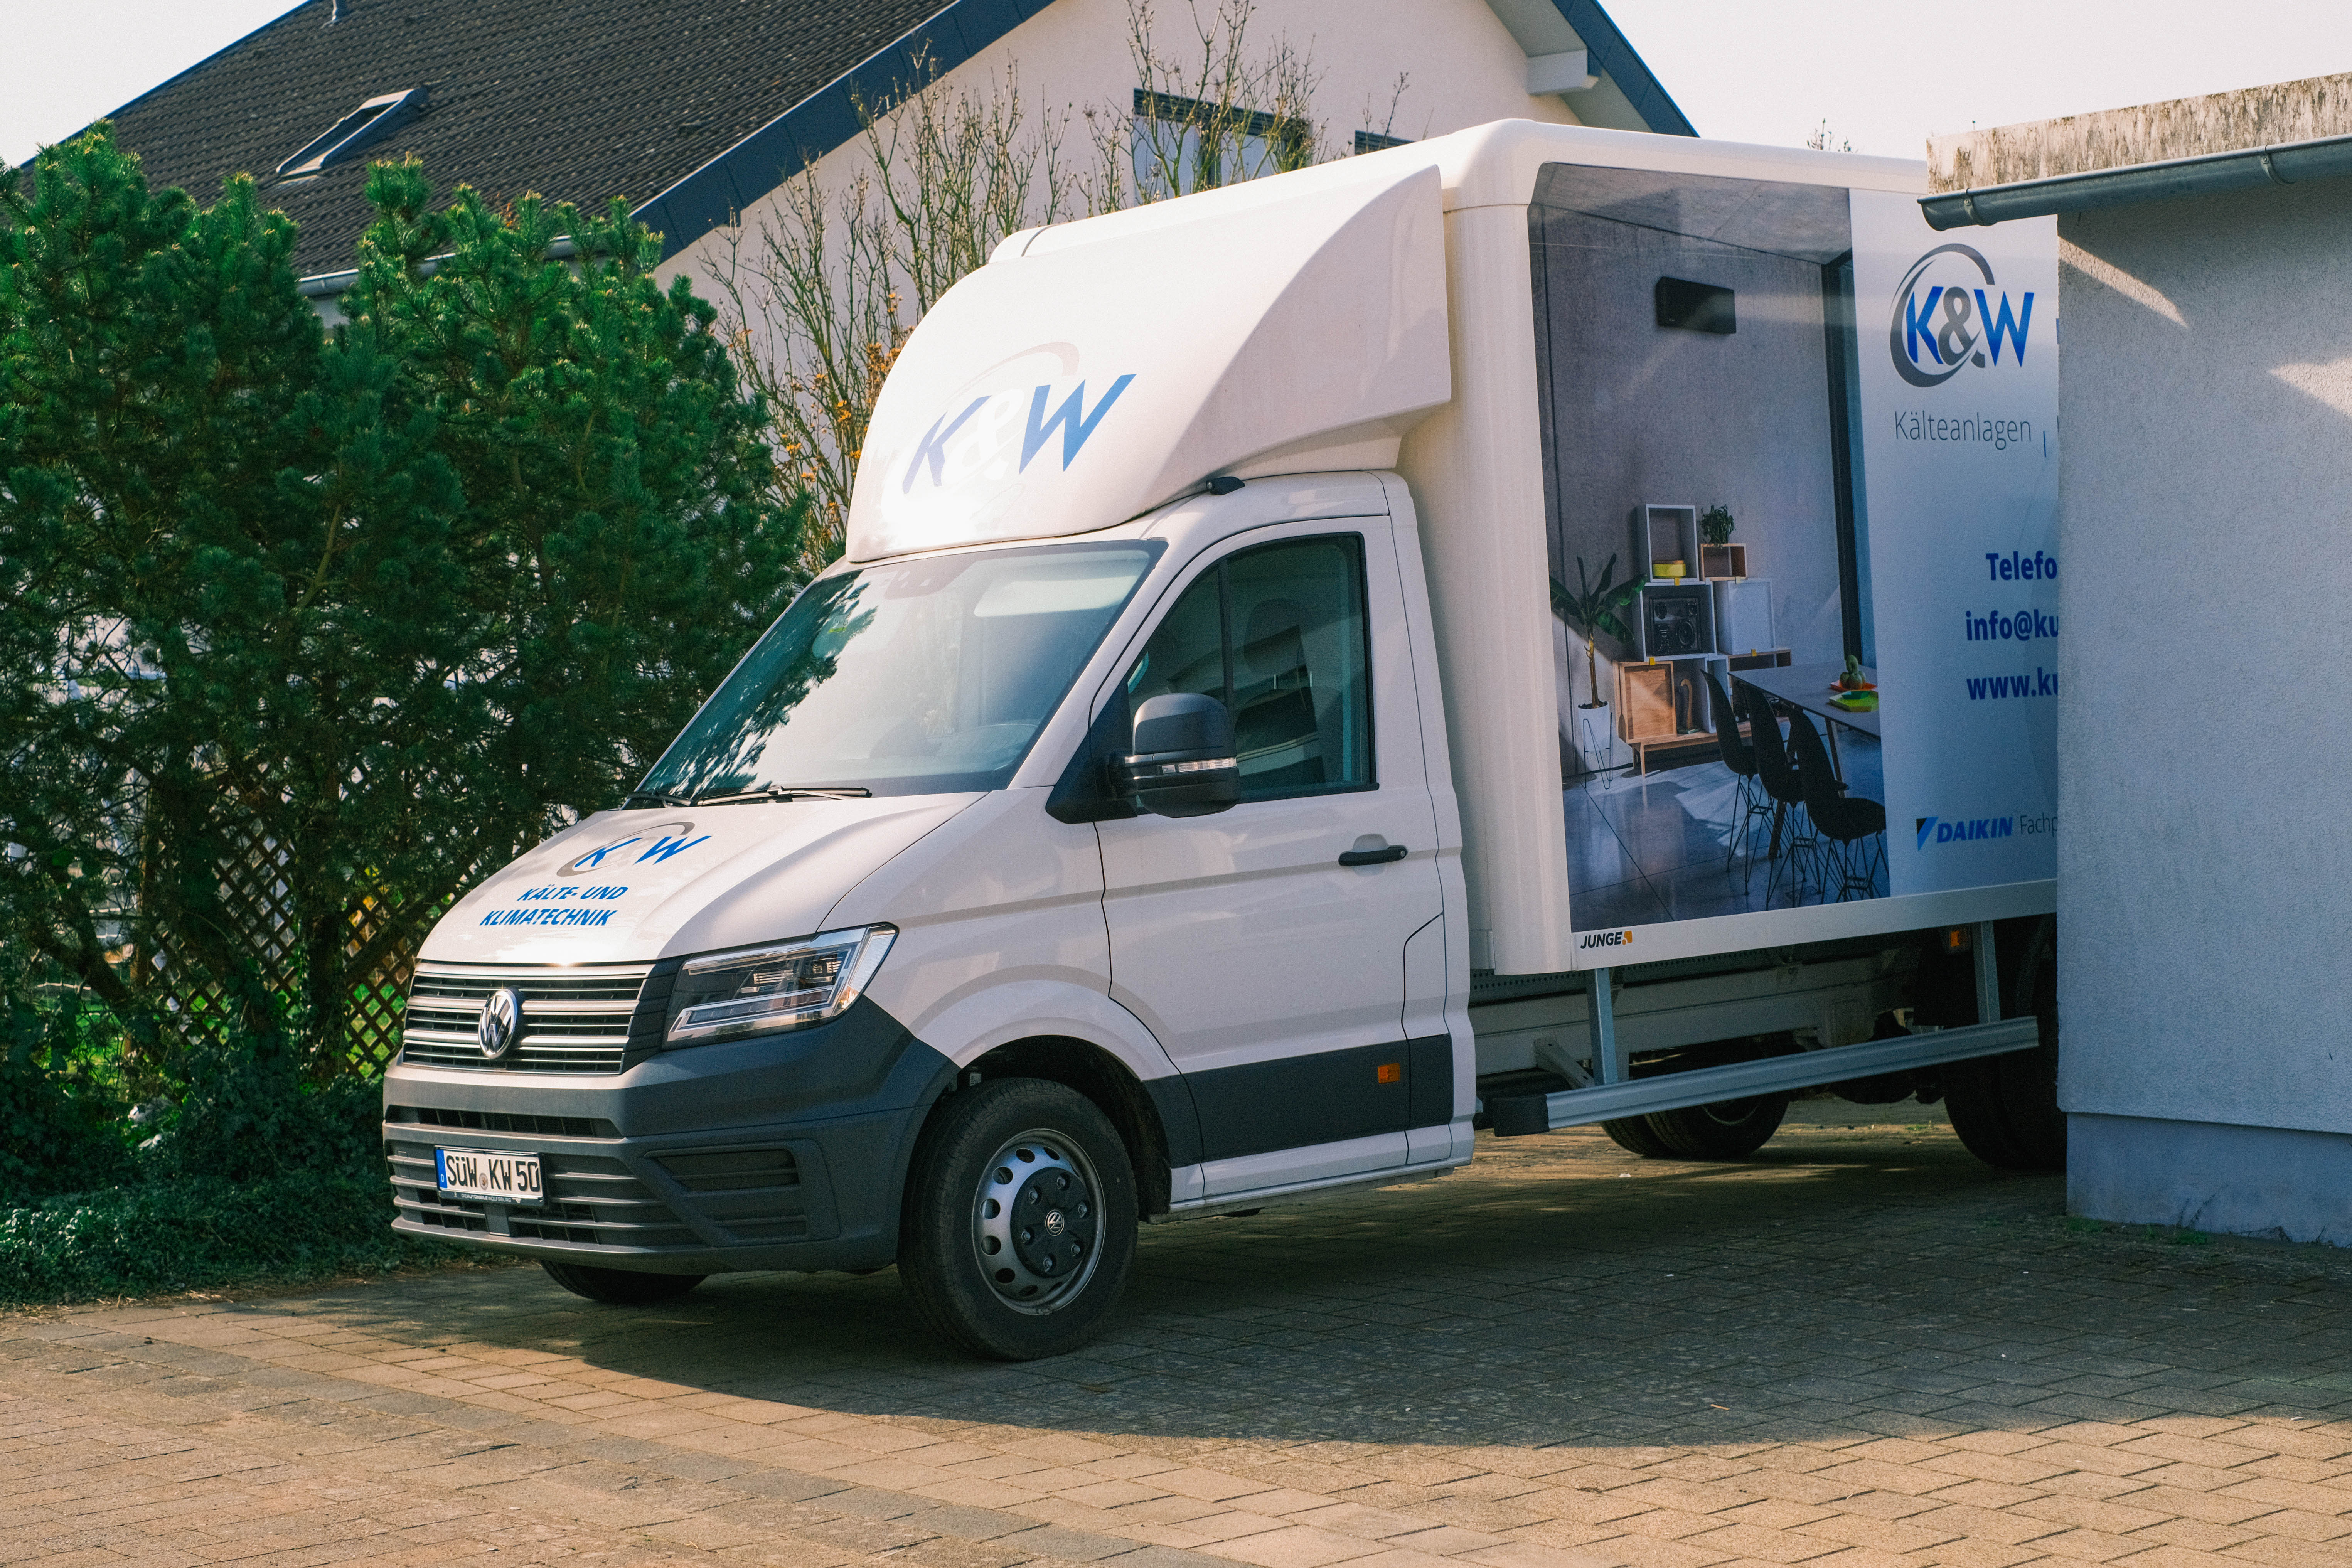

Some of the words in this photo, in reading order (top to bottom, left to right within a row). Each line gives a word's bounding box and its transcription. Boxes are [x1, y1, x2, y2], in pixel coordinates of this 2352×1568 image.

[1906, 286, 2034, 369] K&W
[902, 374, 1137, 495] K&W
[1895, 410, 2031, 450] Kälteanlagen
[1986, 551, 2057, 580] Telefo
[1937, 817, 2013, 843] DAIKIN
[517, 884, 579, 901] KÄLTE-
[580, 886, 628, 900] UND
[479, 908, 618, 926] KLIMATECHNIK
[1580, 931, 1622, 949] JUNGE
[440, 1173, 445, 1182] D
[446, 1155, 477, 1187] SÜW
[488, 1159, 512, 1191] KW
[515, 1160, 540, 1192] 50
